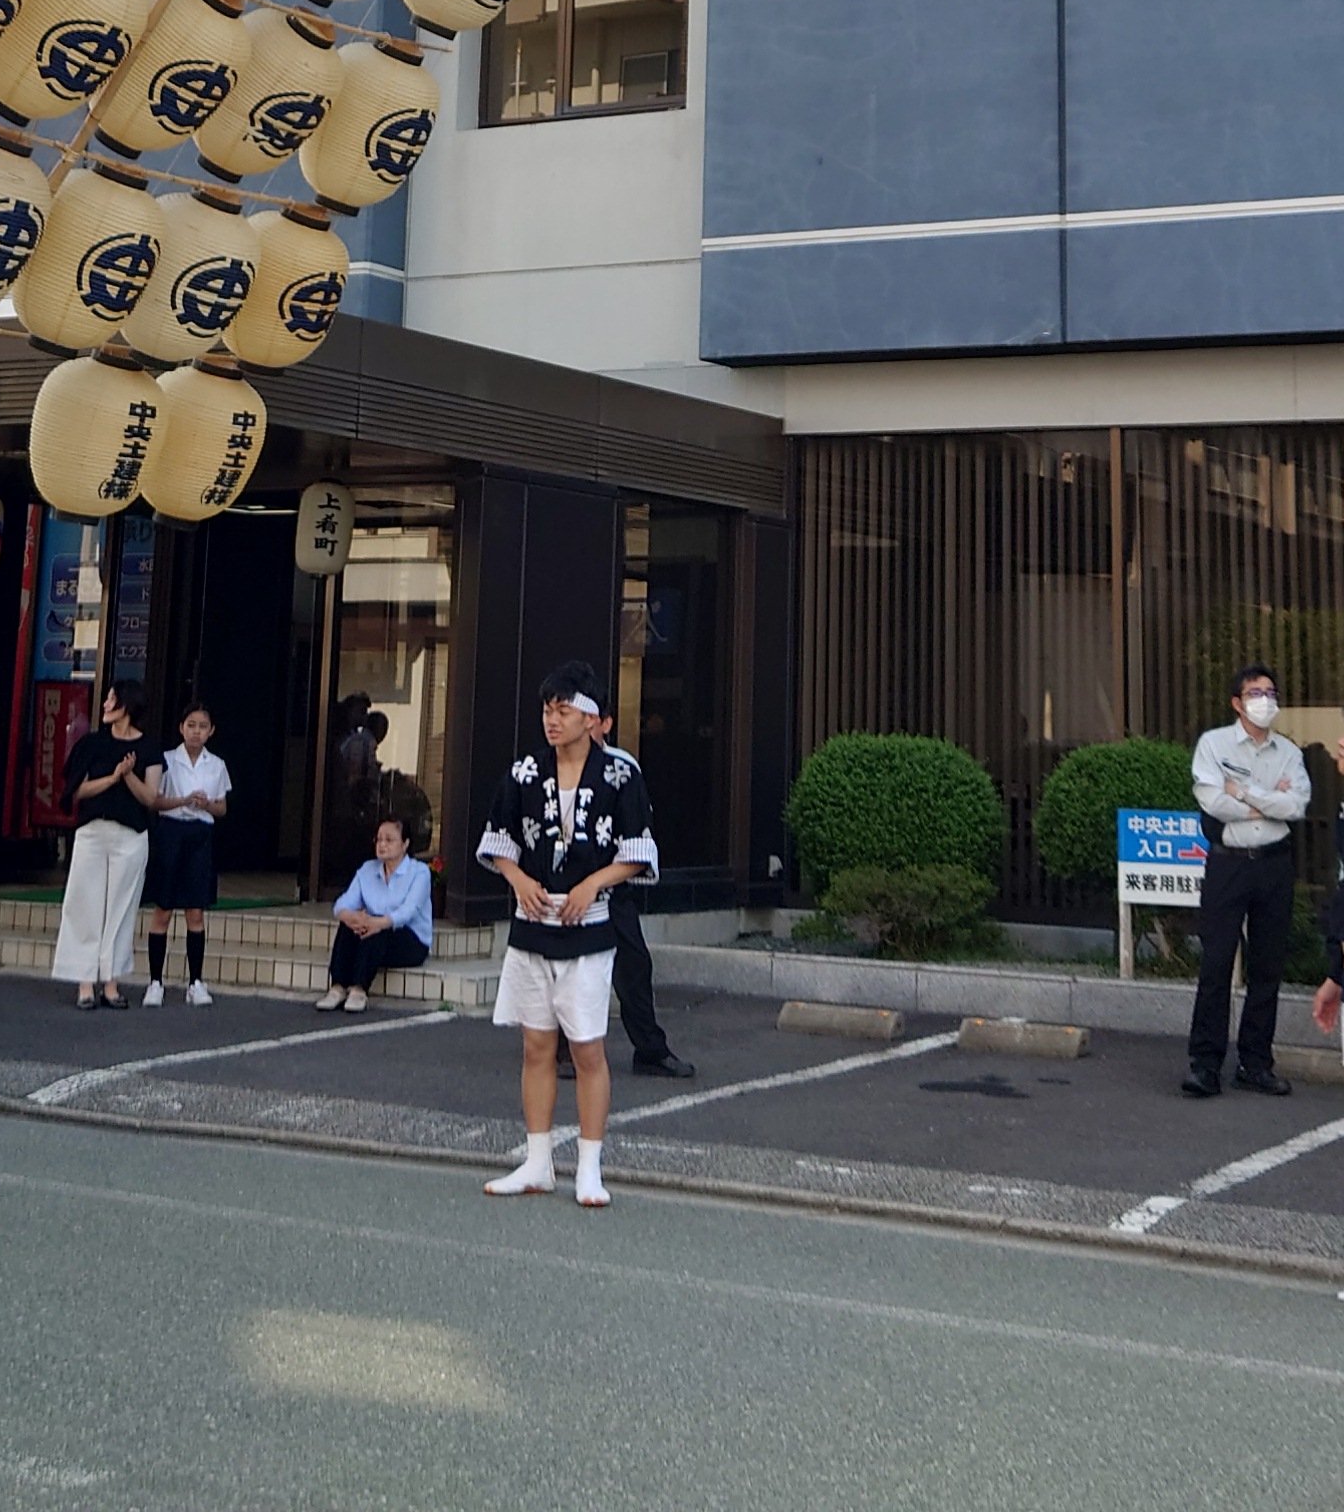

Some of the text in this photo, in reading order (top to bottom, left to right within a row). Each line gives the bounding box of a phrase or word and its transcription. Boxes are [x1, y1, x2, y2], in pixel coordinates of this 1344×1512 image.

[314, 492, 341, 557] 上肴町
[1137, 838, 1173, 859] 入口
